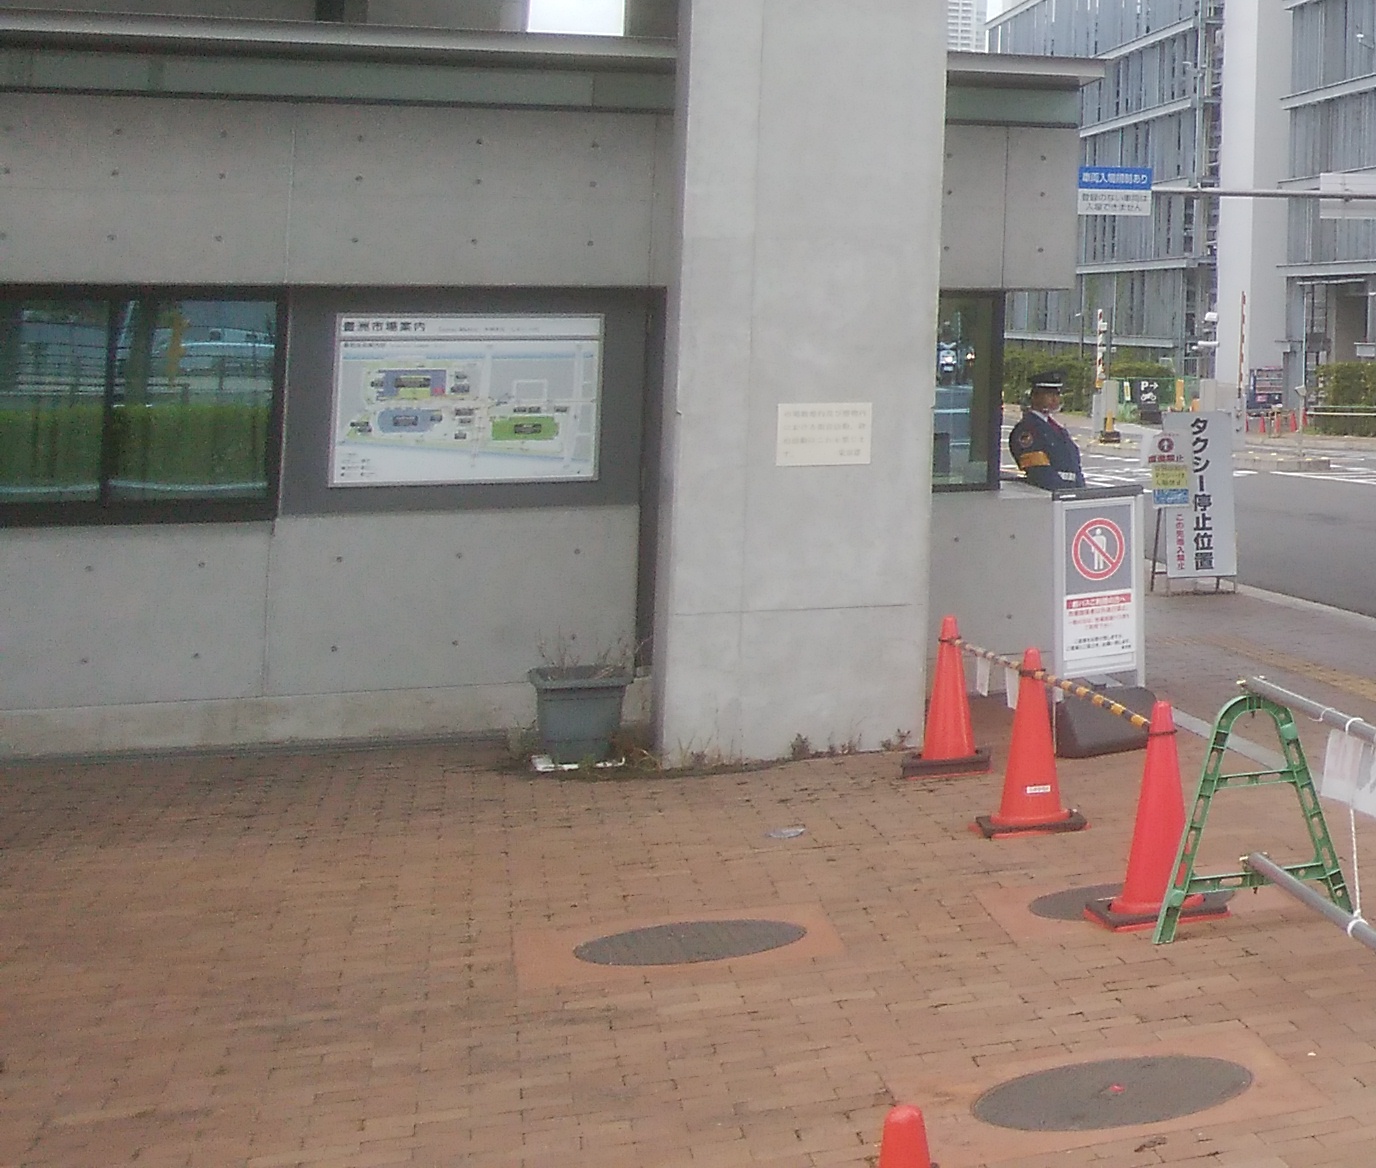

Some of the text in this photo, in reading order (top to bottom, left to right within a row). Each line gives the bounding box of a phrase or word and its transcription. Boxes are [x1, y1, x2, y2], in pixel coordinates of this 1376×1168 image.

[1190, 417, 1214, 570] タクシー停止位置
